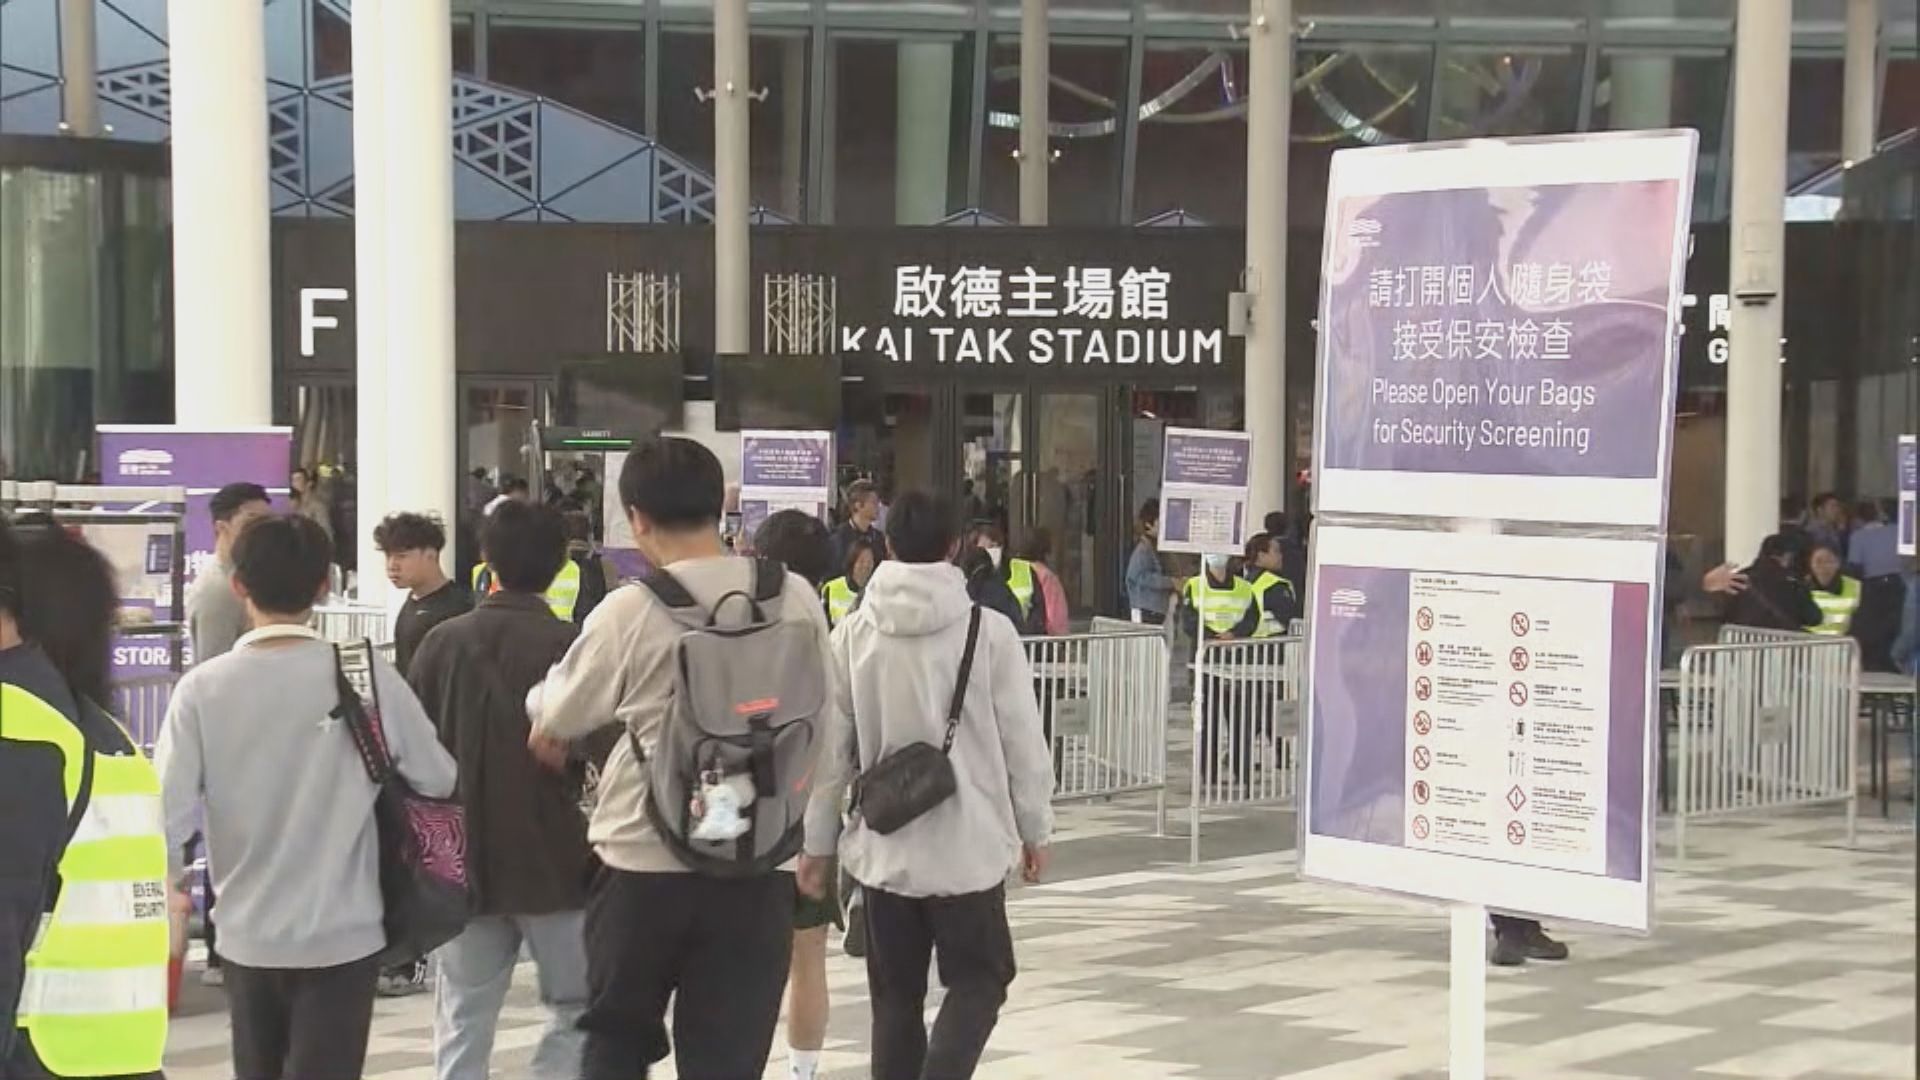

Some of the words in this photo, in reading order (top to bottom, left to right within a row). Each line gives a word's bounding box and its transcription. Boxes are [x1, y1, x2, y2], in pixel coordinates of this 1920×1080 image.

[893, 265, 1171, 320] 啟德主場館
[1369, 261, 1612, 307] 請打開個人隨身袋
[300, 287, 348, 357] F
[1391, 317, 1573, 361] 接受保安檢查
[842, 326, 913, 363] KAI
[929, 327, 1013, 363] TAK
[1028, 327, 1222, 364] STADIUM
[1372, 377, 1428, 405] Please
[1432, 377, 1478, 410] Open
[1484, 377, 1535, 406] Your
[1539, 378, 1596, 412] Bags
[1373, 419, 1398, 443] for
[1400, 418, 1476, 452] Security
[1479, 419, 1590, 455] Screening
